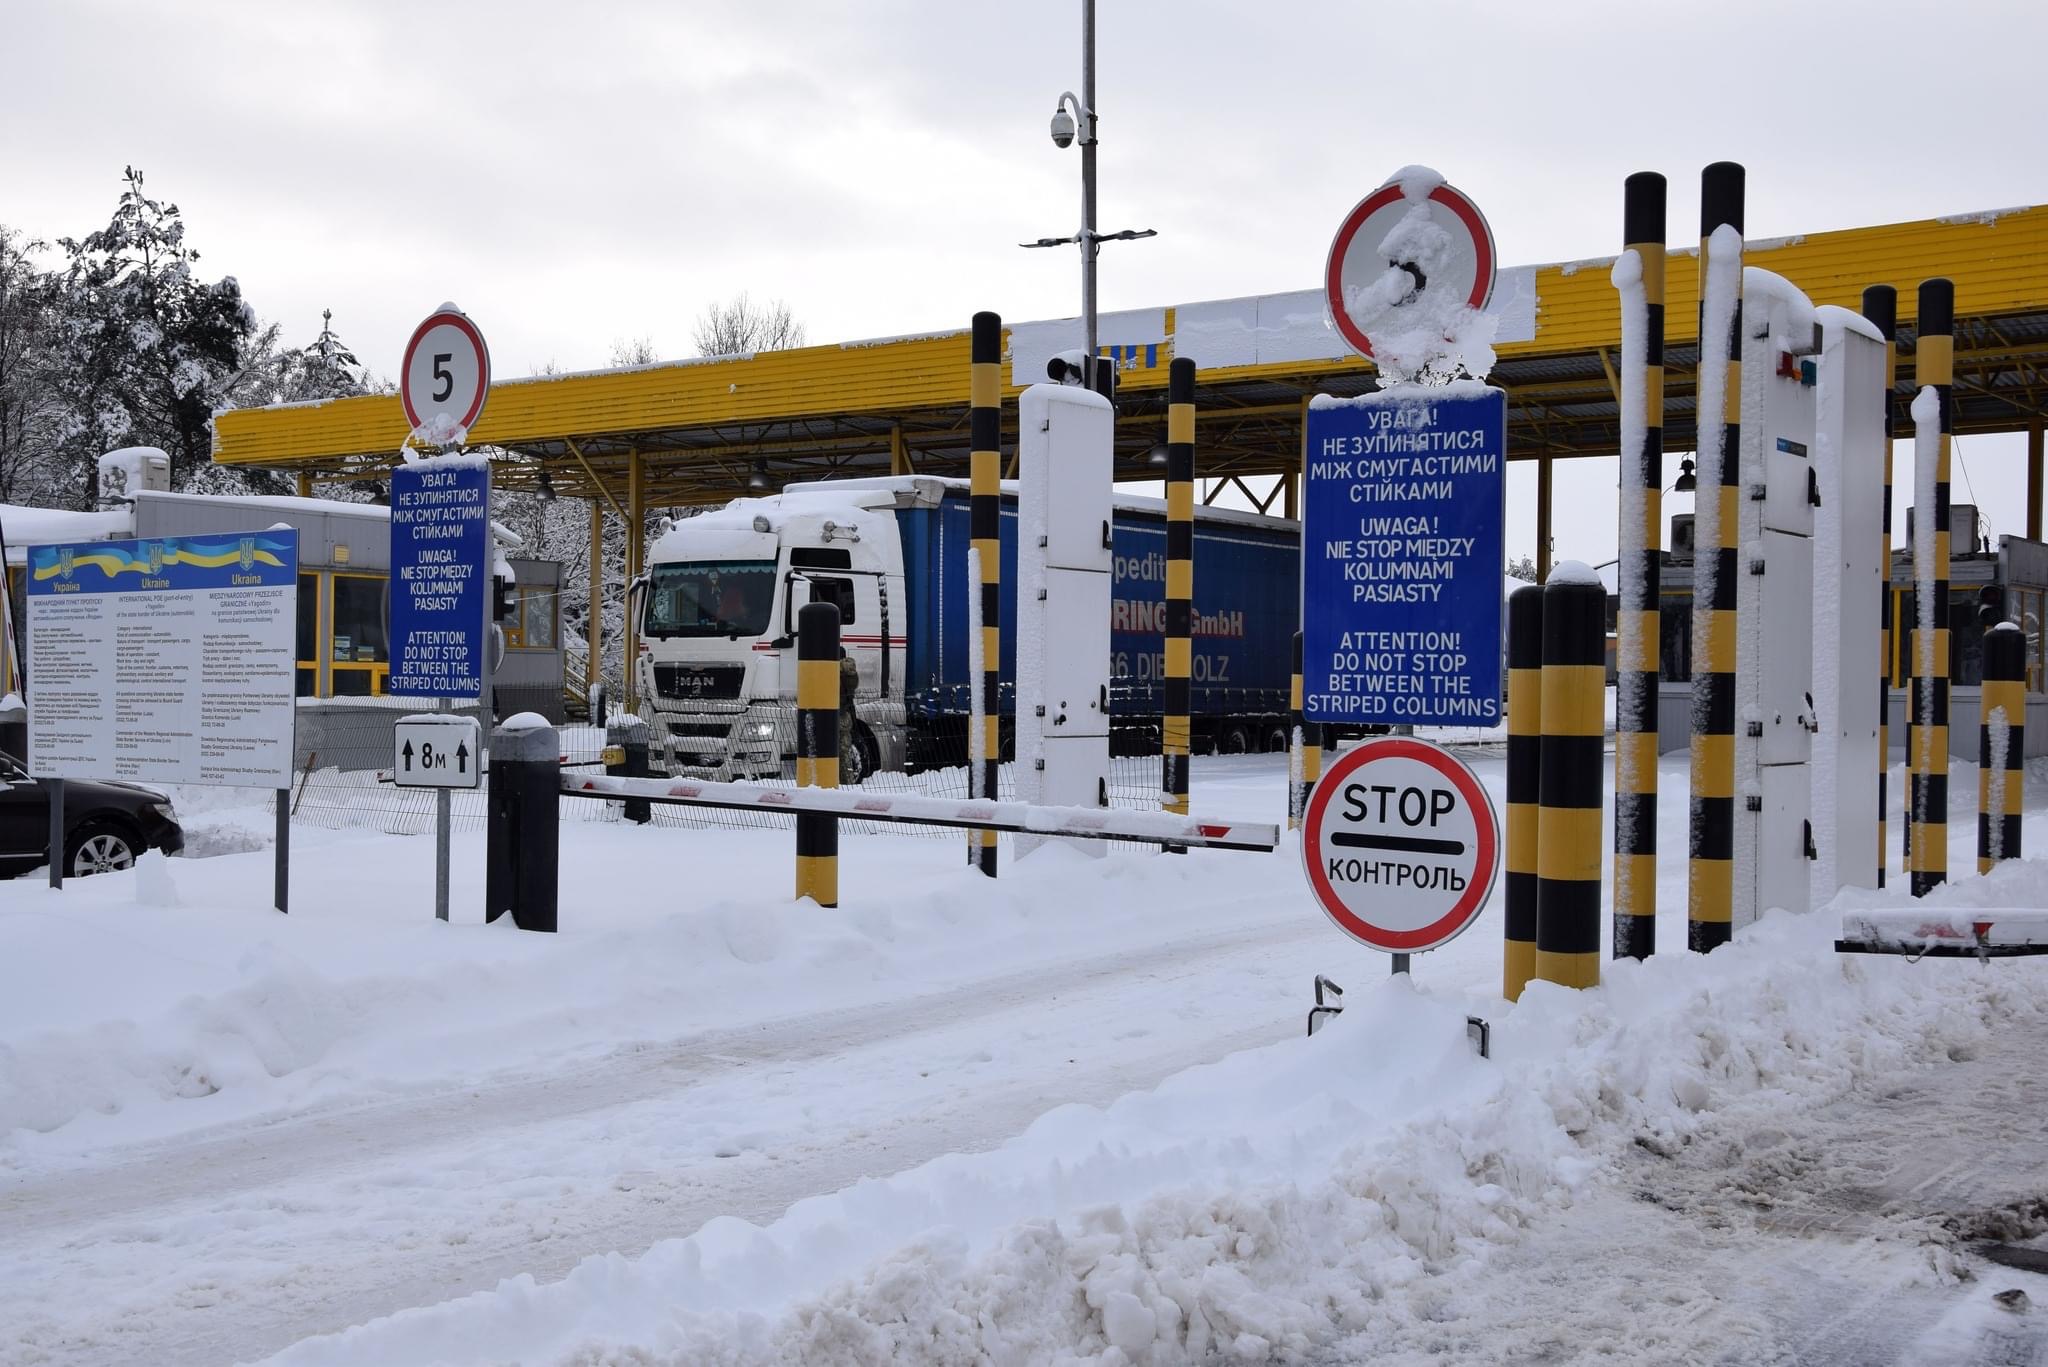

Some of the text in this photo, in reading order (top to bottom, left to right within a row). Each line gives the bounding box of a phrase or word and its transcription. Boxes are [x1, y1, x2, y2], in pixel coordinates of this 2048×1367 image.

[433, 353, 453, 402] 5
[1323, 431, 1484, 456] НЕ ЗУПИНЯТИСЯ
[1311, 455, 1496, 480] МІЖ СМУГАСТИМИ
[421, 473, 457, 488] УВАГА!
[399, 489, 479, 506] НЕ ЗУПИНЯТИСЯ
[1350, 479, 1453, 503] СТІЙКАМИ
[393, 506, 484, 524] МІЖ СМУГАСТИМИ
[412, 523, 464, 540] СТІЙКАМИ
[1326, 538, 1476, 561] NIE STOP MIĘDZY
[400, 565, 473, 581] NIE STOP MIĘDZY
[1111, 552, 1165, 584] pedit
[1344, 561, 1454, 581] KOLUMNAMI
[53, 581, 81, 593] Україна
[141, 578, 170, 589] Ukraine
[231, 573, 262, 585] Ukraina
[410, 581, 464, 595] KOLUMNAMI
[1353, 584, 1443, 603] PASIASTY
[414, 597, 458, 611] PASIASTY
[1111, 599, 1166, 636] RING
[408, 631, 466, 645] ATTENTION!
[1340, 632, 1461, 651] ATTENTION!
[405, 646, 468, 661] DO NOT STOP
[1333, 653, 1467, 673] DO NOT STOP
[402, 661, 470, 675] BETWEEN THE
[1137, 652, 1230, 682] DIEOLZ
[391, 676, 480, 691] STRIPED COLUMNS
[680, 676, 715, 687] MAN
[1329, 674, 1471, 694] BETWEEN THE
[1307, 694, 1497, 717] STRIPED COLUMNS
[1342, 783, 1455, 827] STOP
[1328, 858, 1466, 892] КОНТРОЛЬ
